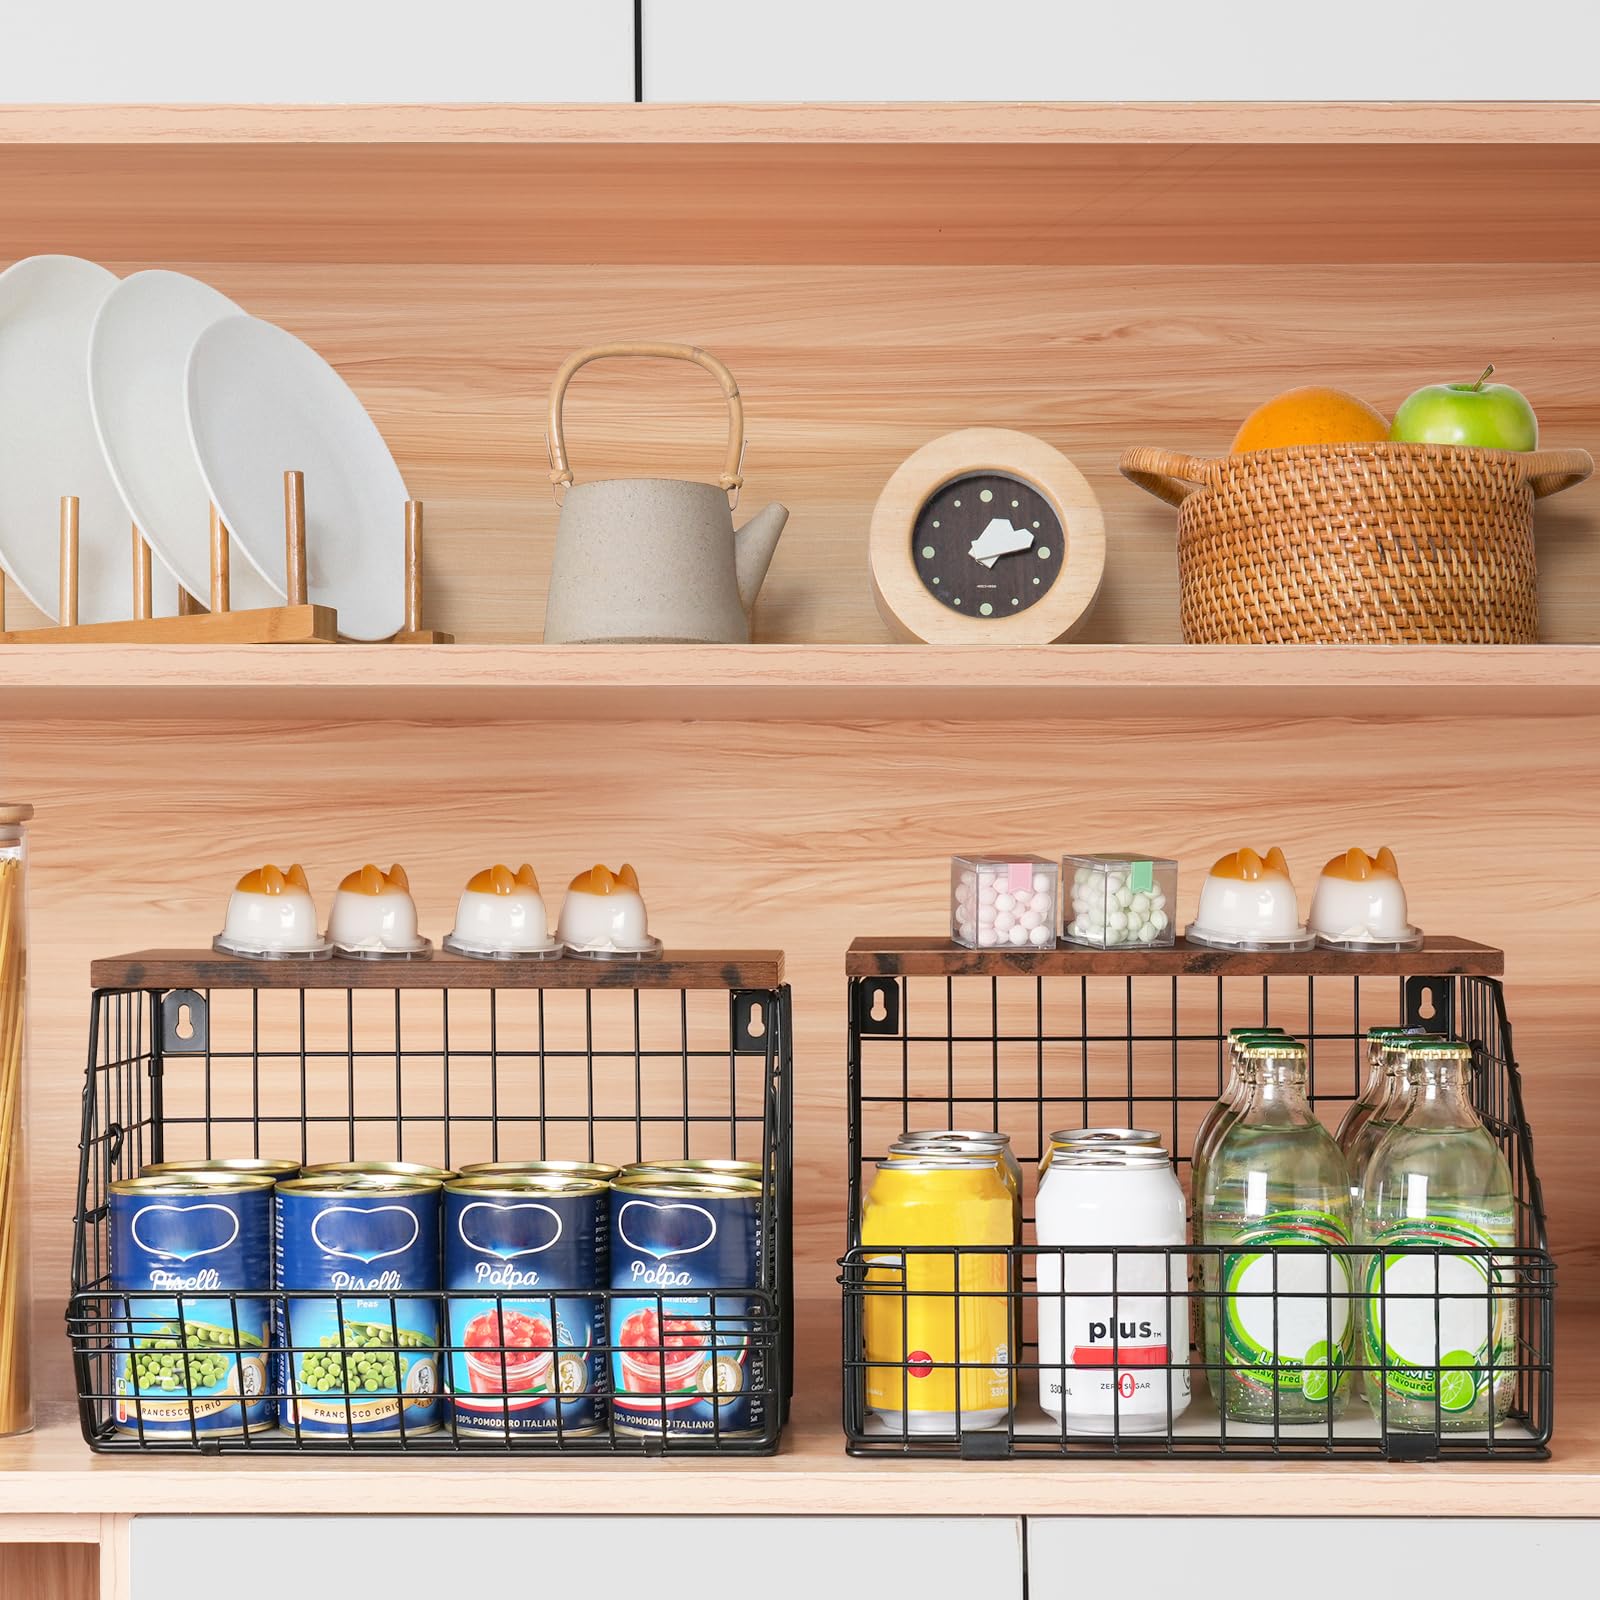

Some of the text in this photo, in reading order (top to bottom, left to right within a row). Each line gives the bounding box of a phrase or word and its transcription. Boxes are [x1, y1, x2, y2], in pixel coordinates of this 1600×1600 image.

[331, 1270, 402, 1291] Piselli
[475, 1262, 540, 1290] Polpa
[631, 1260, 692, 1289] Polpa
[1089, 1317, 1152, 1343] plus
[141, 1399, 221, 1417] RANCESCO CIRIO
[314, 1408, 371, 1418] FRANCSCO
[522, 1418, 564, 1428] ITALIAN
[672, 1420, 715, 1429] ITALIANO
